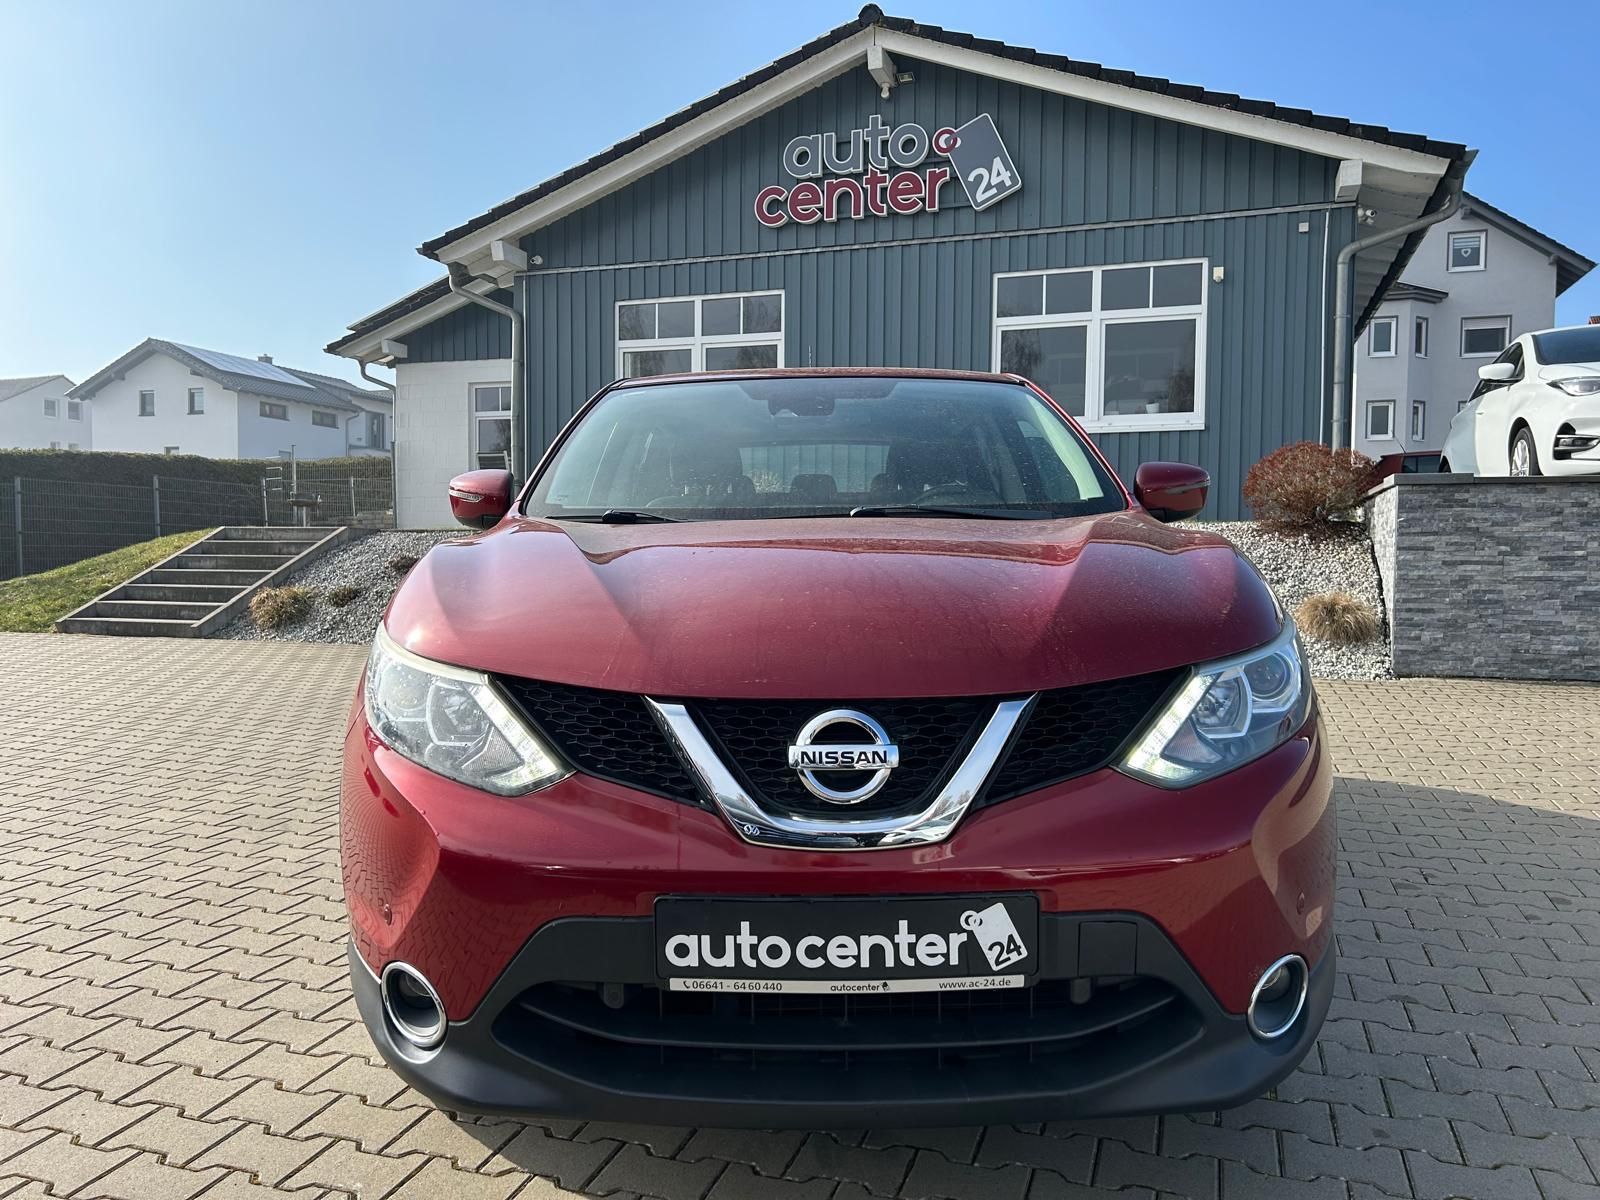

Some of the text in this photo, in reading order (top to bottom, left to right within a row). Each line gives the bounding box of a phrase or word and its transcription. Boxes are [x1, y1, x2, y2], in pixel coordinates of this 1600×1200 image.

[783, 114, 929, 179] auto
[967, 155, 1012, 203] 24
[754, 163, 950, 228] center
[800, 750, 888, 765] NISSAN
[665, 919, 1023, 969] autocenter 24
[692, 980, 724, 990] 06641
[830, 981, 880, 992] autocenter
[938, 978, 1012, 989] www.ac-24.de
